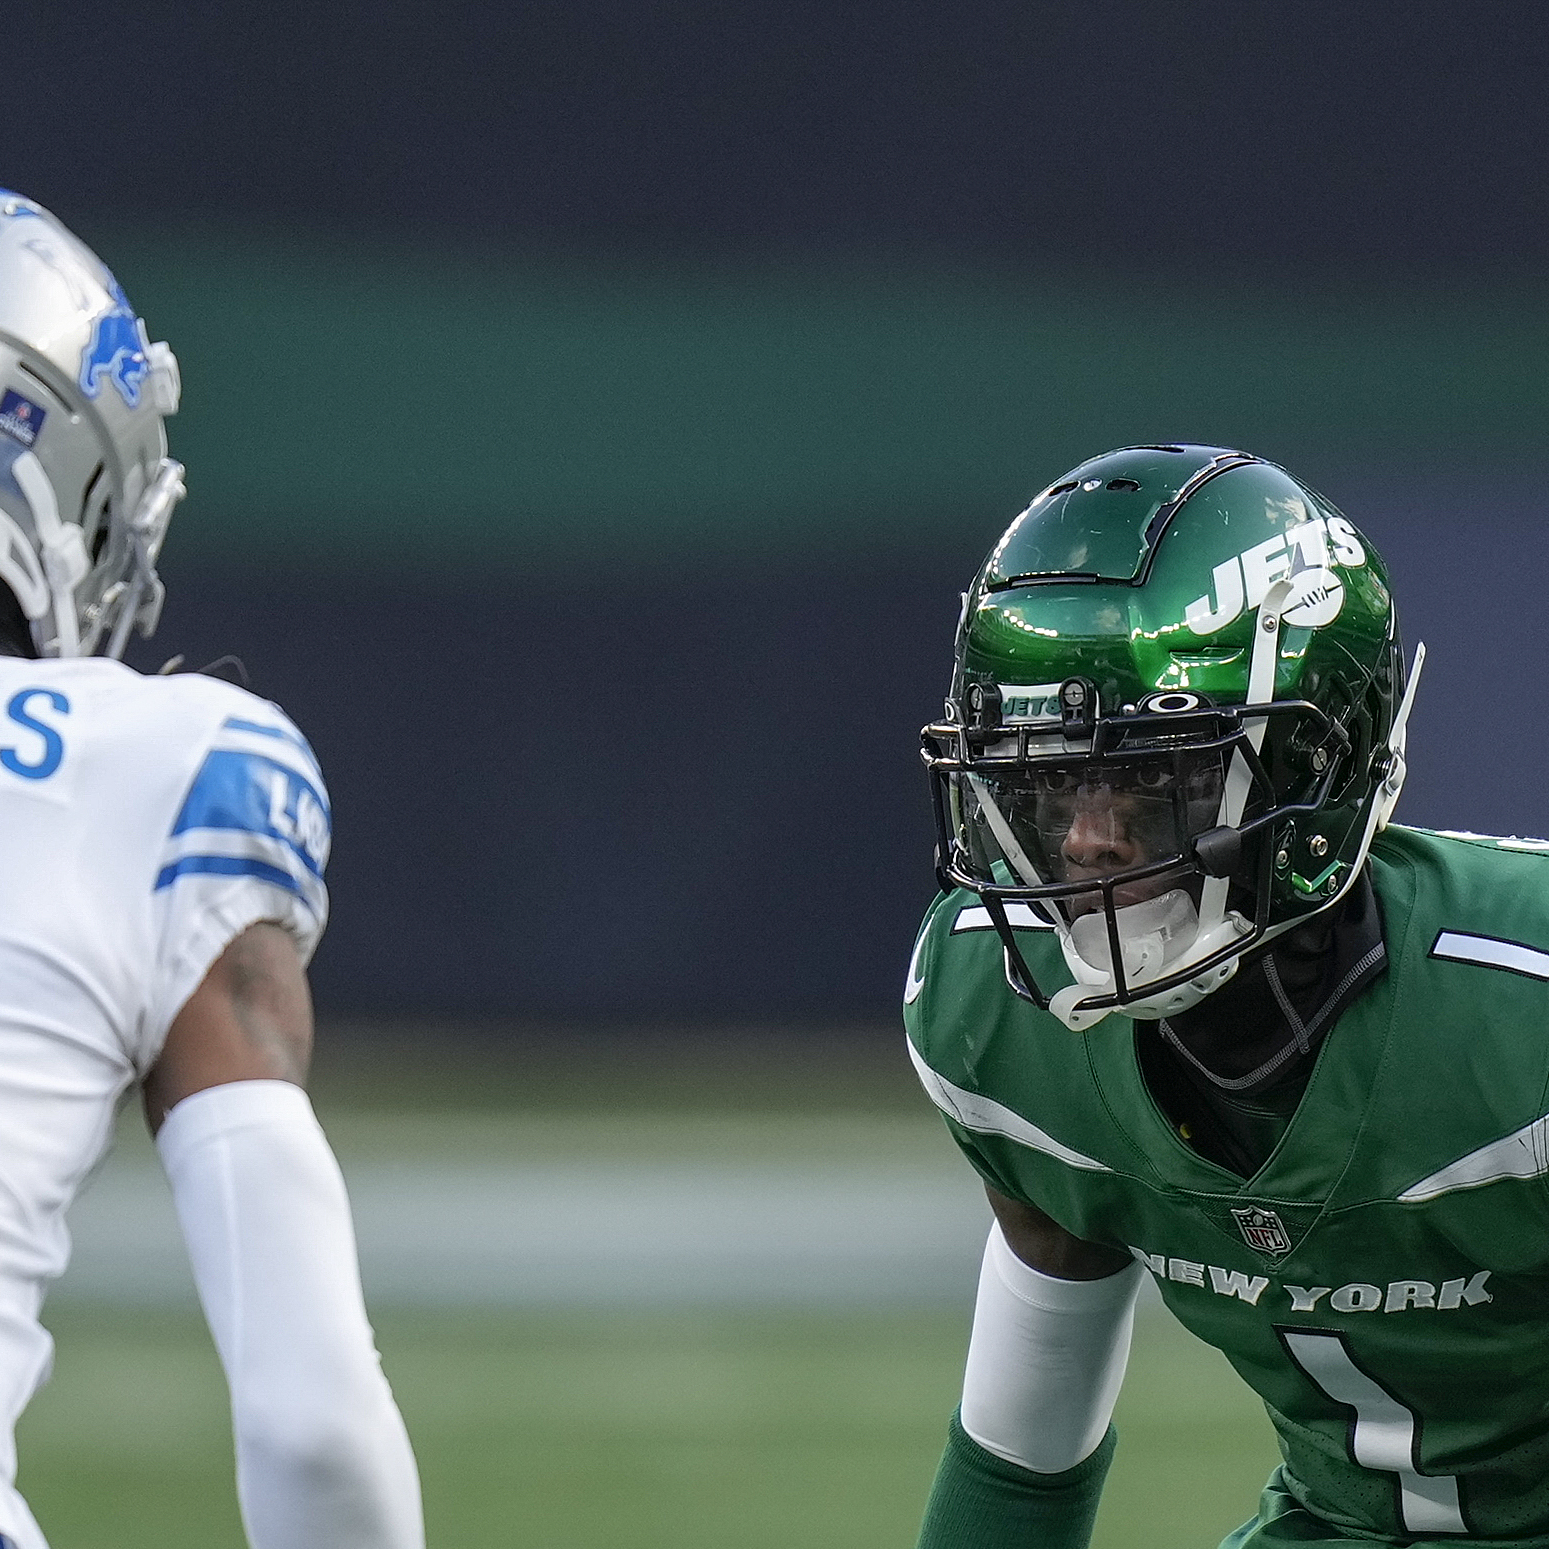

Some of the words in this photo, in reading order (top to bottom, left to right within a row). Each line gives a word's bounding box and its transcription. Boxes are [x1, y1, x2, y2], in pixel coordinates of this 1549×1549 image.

[1184, 516, 1368, 637] JETS
[1001, 694, 1063, 717] JETS
[1245, 1228, 1286, 1251] NFL
[1128, 1244, 1270, 1307] NEW
[1282, 1269, 1494, 1314] YORK
[1271, 1323, 1472, 1536] 1
